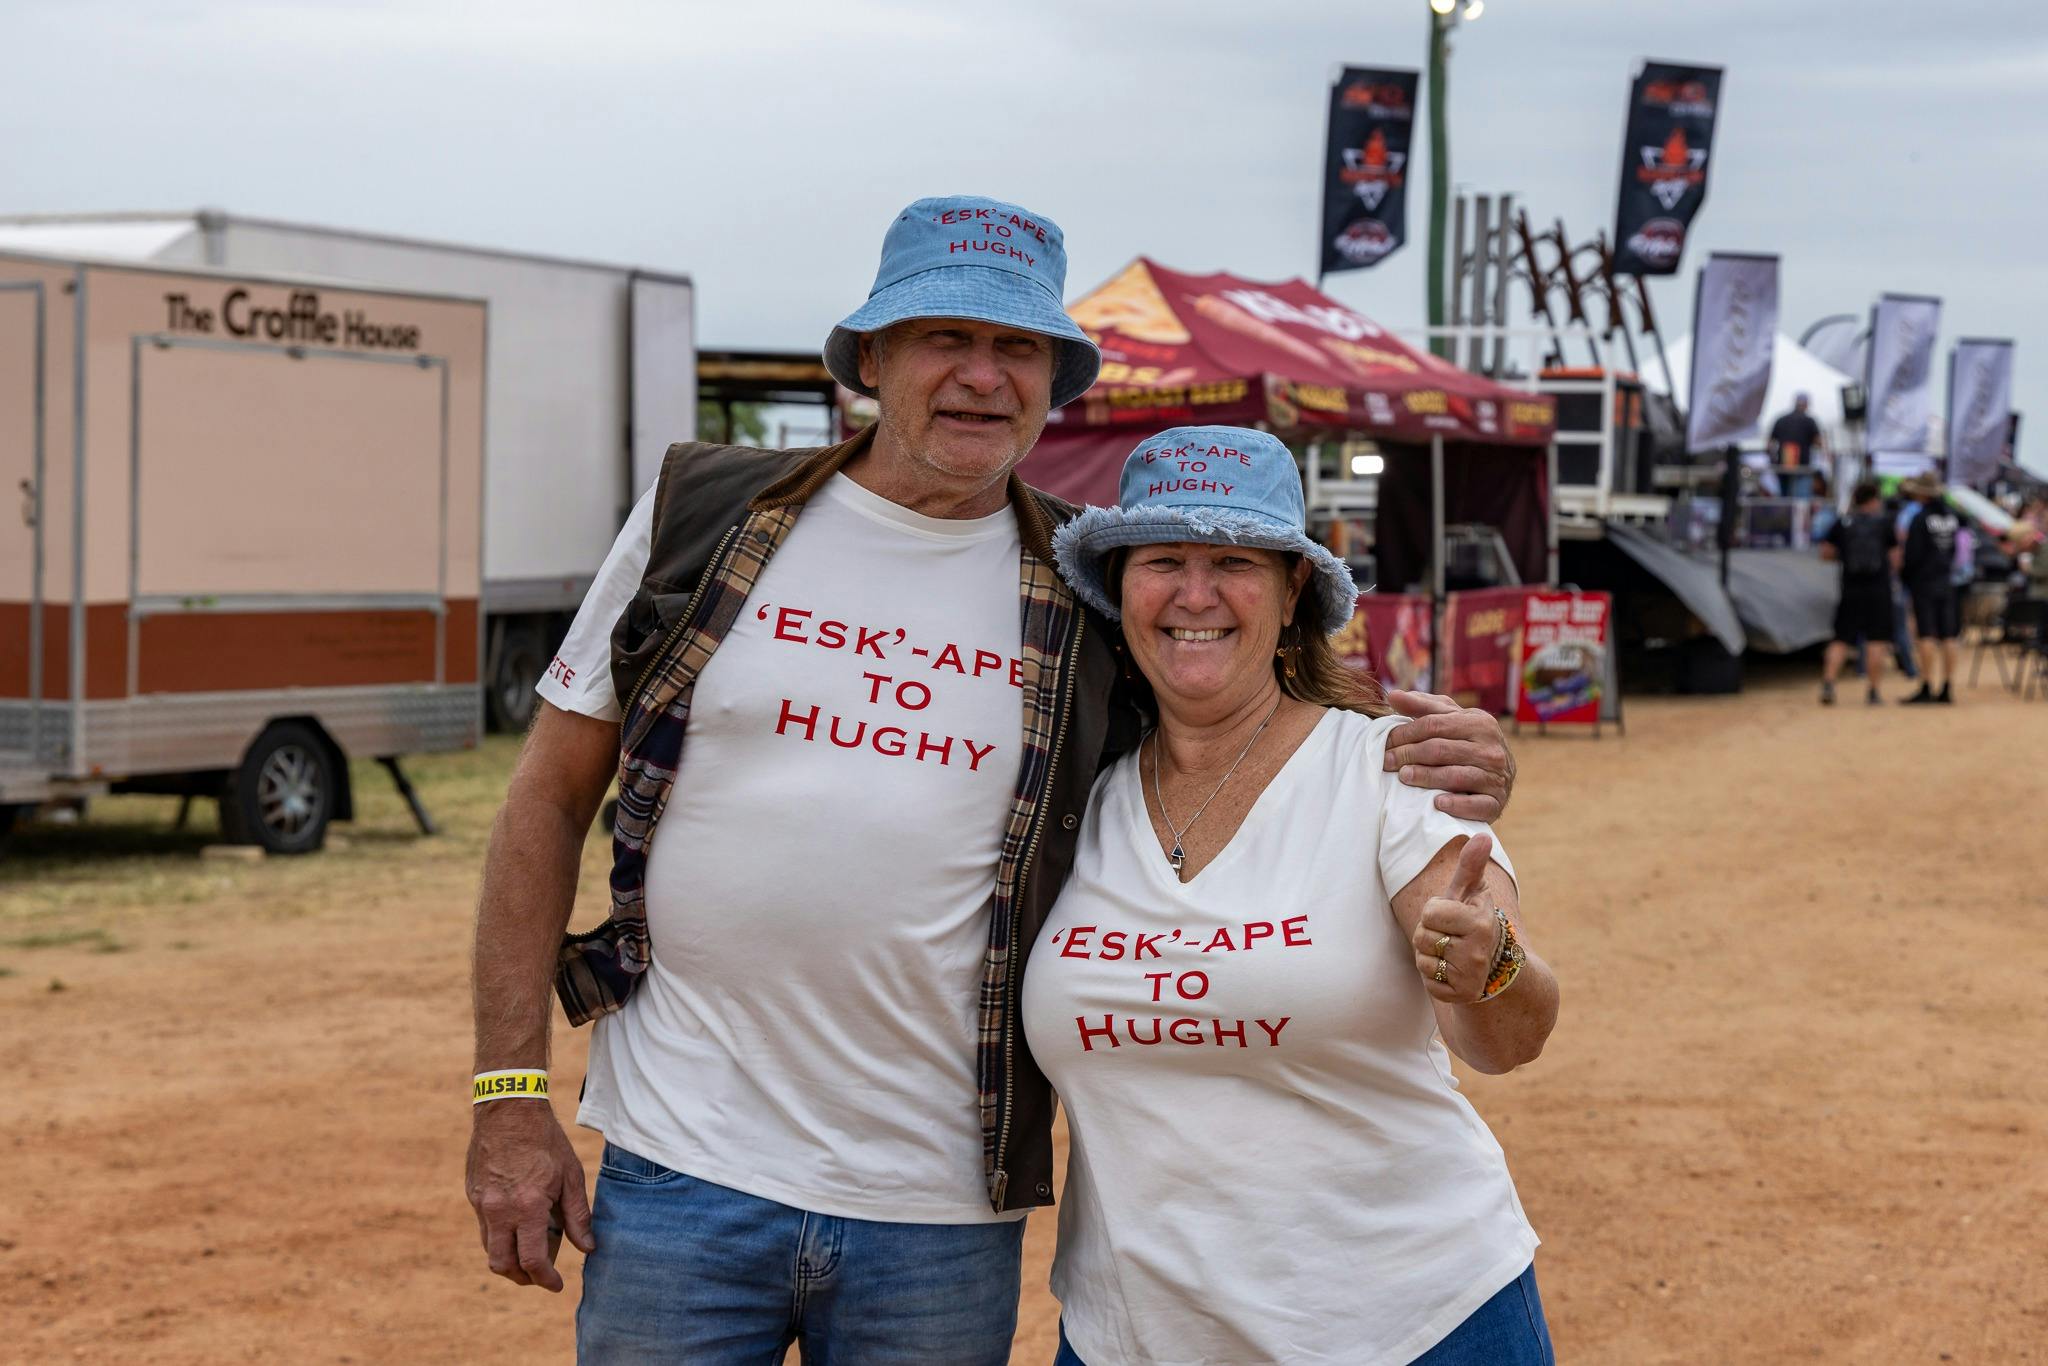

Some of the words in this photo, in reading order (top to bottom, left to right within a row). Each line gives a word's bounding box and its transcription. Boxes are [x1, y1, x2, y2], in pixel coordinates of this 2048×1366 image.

[982, 223, 1011, 238] TO
[950, 240, 1035, 266] HUGHY
[164, 292, 214, 333] The
[222, 287, 338, 343] Croffle
[344, 310, 421, 350] House
[1178, 461, 1207, 472] TO
[1148, 478, 1234, 497] HUGHY
[863, 671, 932, 711] TO
[775, 699, 996, 772] HUGHY
[1144, 970, 1210, 1001] TO
[1076, 1014, 1291, 1051] HUGHY
[474, 1076, 527, 1098] FESTIV
